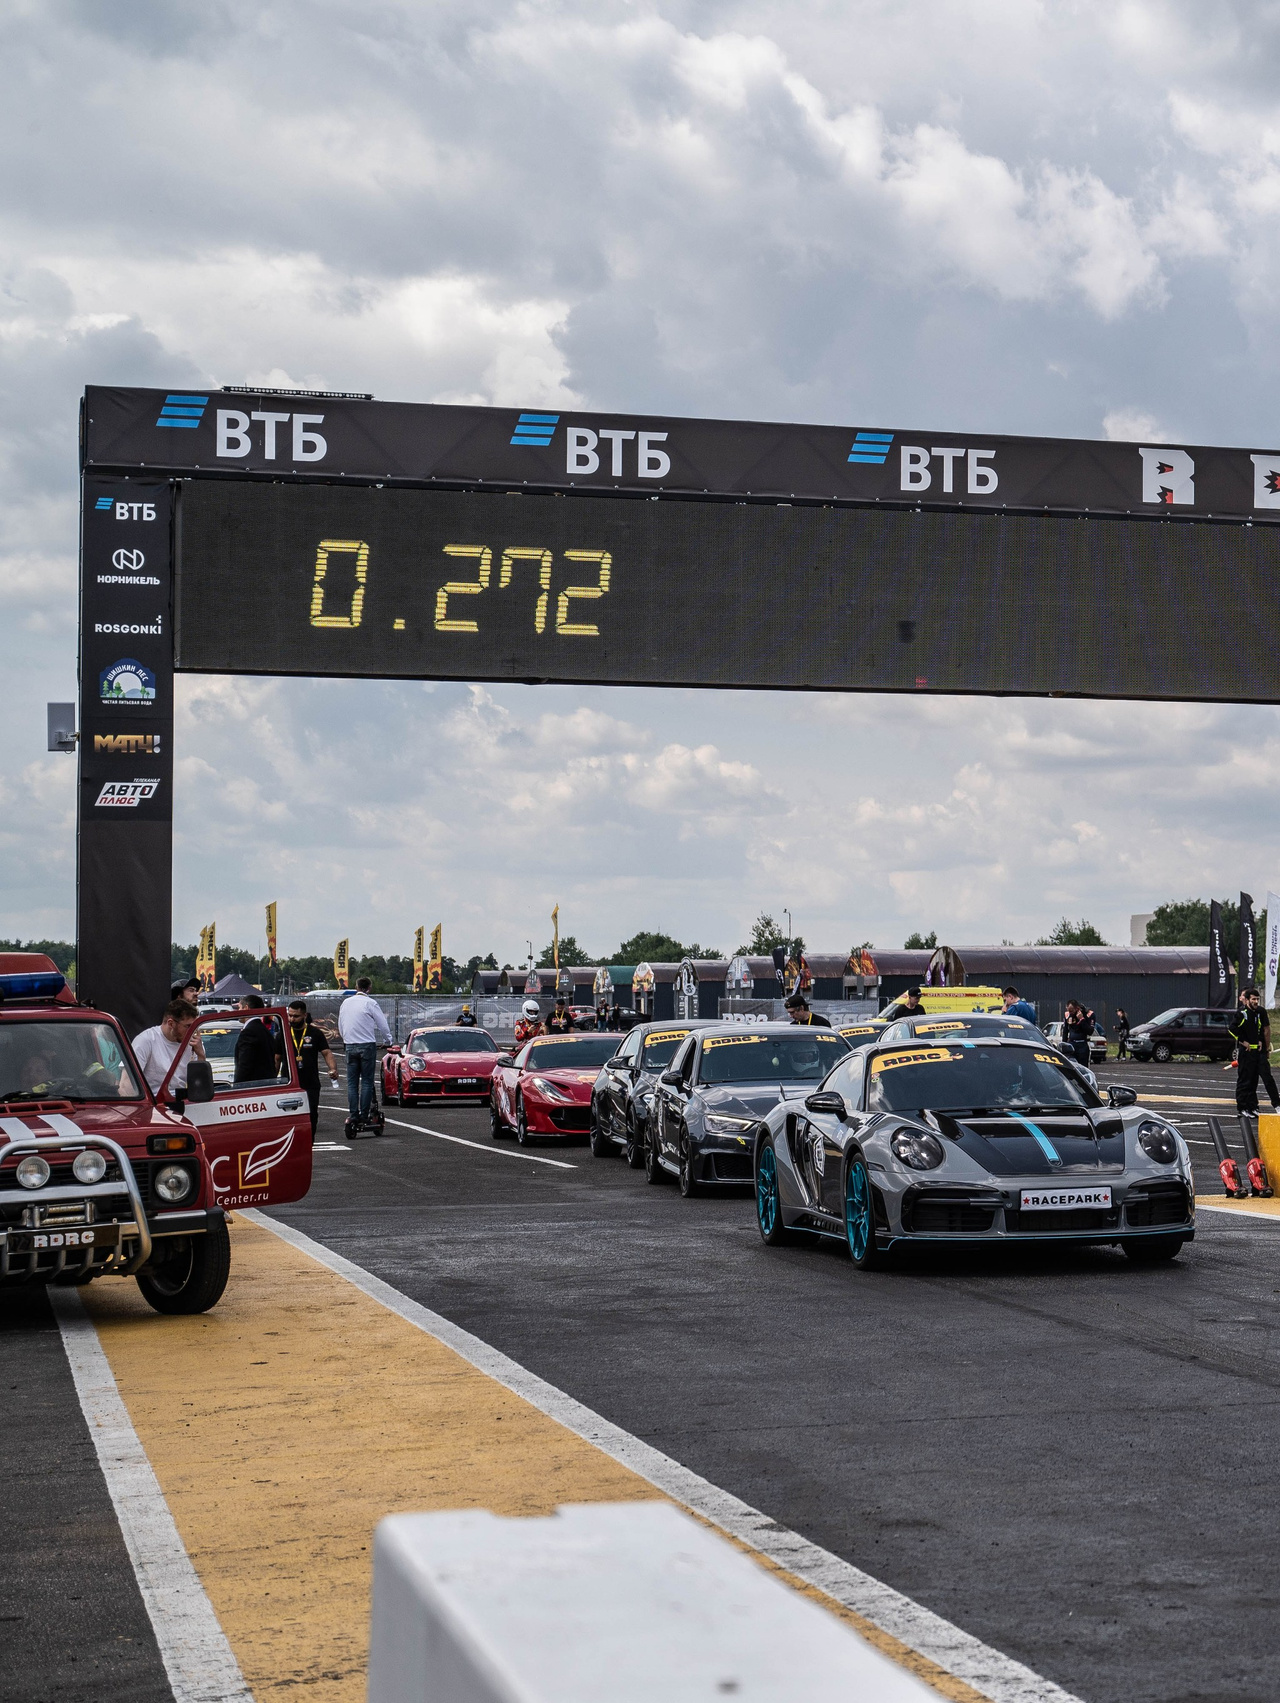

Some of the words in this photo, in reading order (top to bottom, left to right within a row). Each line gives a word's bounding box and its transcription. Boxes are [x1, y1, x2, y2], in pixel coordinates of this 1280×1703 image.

[216, 409, 327, 462] ВТБ
[566, 428, 670, 478] ВТБ
[901, 446, 998, 494] ВТБ
[115, 502, 156, 521] ВТБ
[97, 575, 160, 585] НОРНИКЕЛЬ
[95, 623, 162, 635] ROSGONKI
[107, 664, 136, 681] ШИШКИН
[136, 668, 149, 682] ЛЕС
[94, 735, 161, 753] МАТЧ!
[103, 785, 153, 796] АВТО
[99, 797, 136, 805] ПЛЮС
[650, 1033, 686, 1042] RDRC
[711, 1036, 752, 1045] RDRC
[882, 1053, 941, 1067] RDRC
[1033, 1053, 1063, 1065] 911
[219, 1102, 267, 1117] МОСКВА
[1031, 1194, 1102, 1205] RACEPARK
[33, 1231, 95, 1247] RDRC
